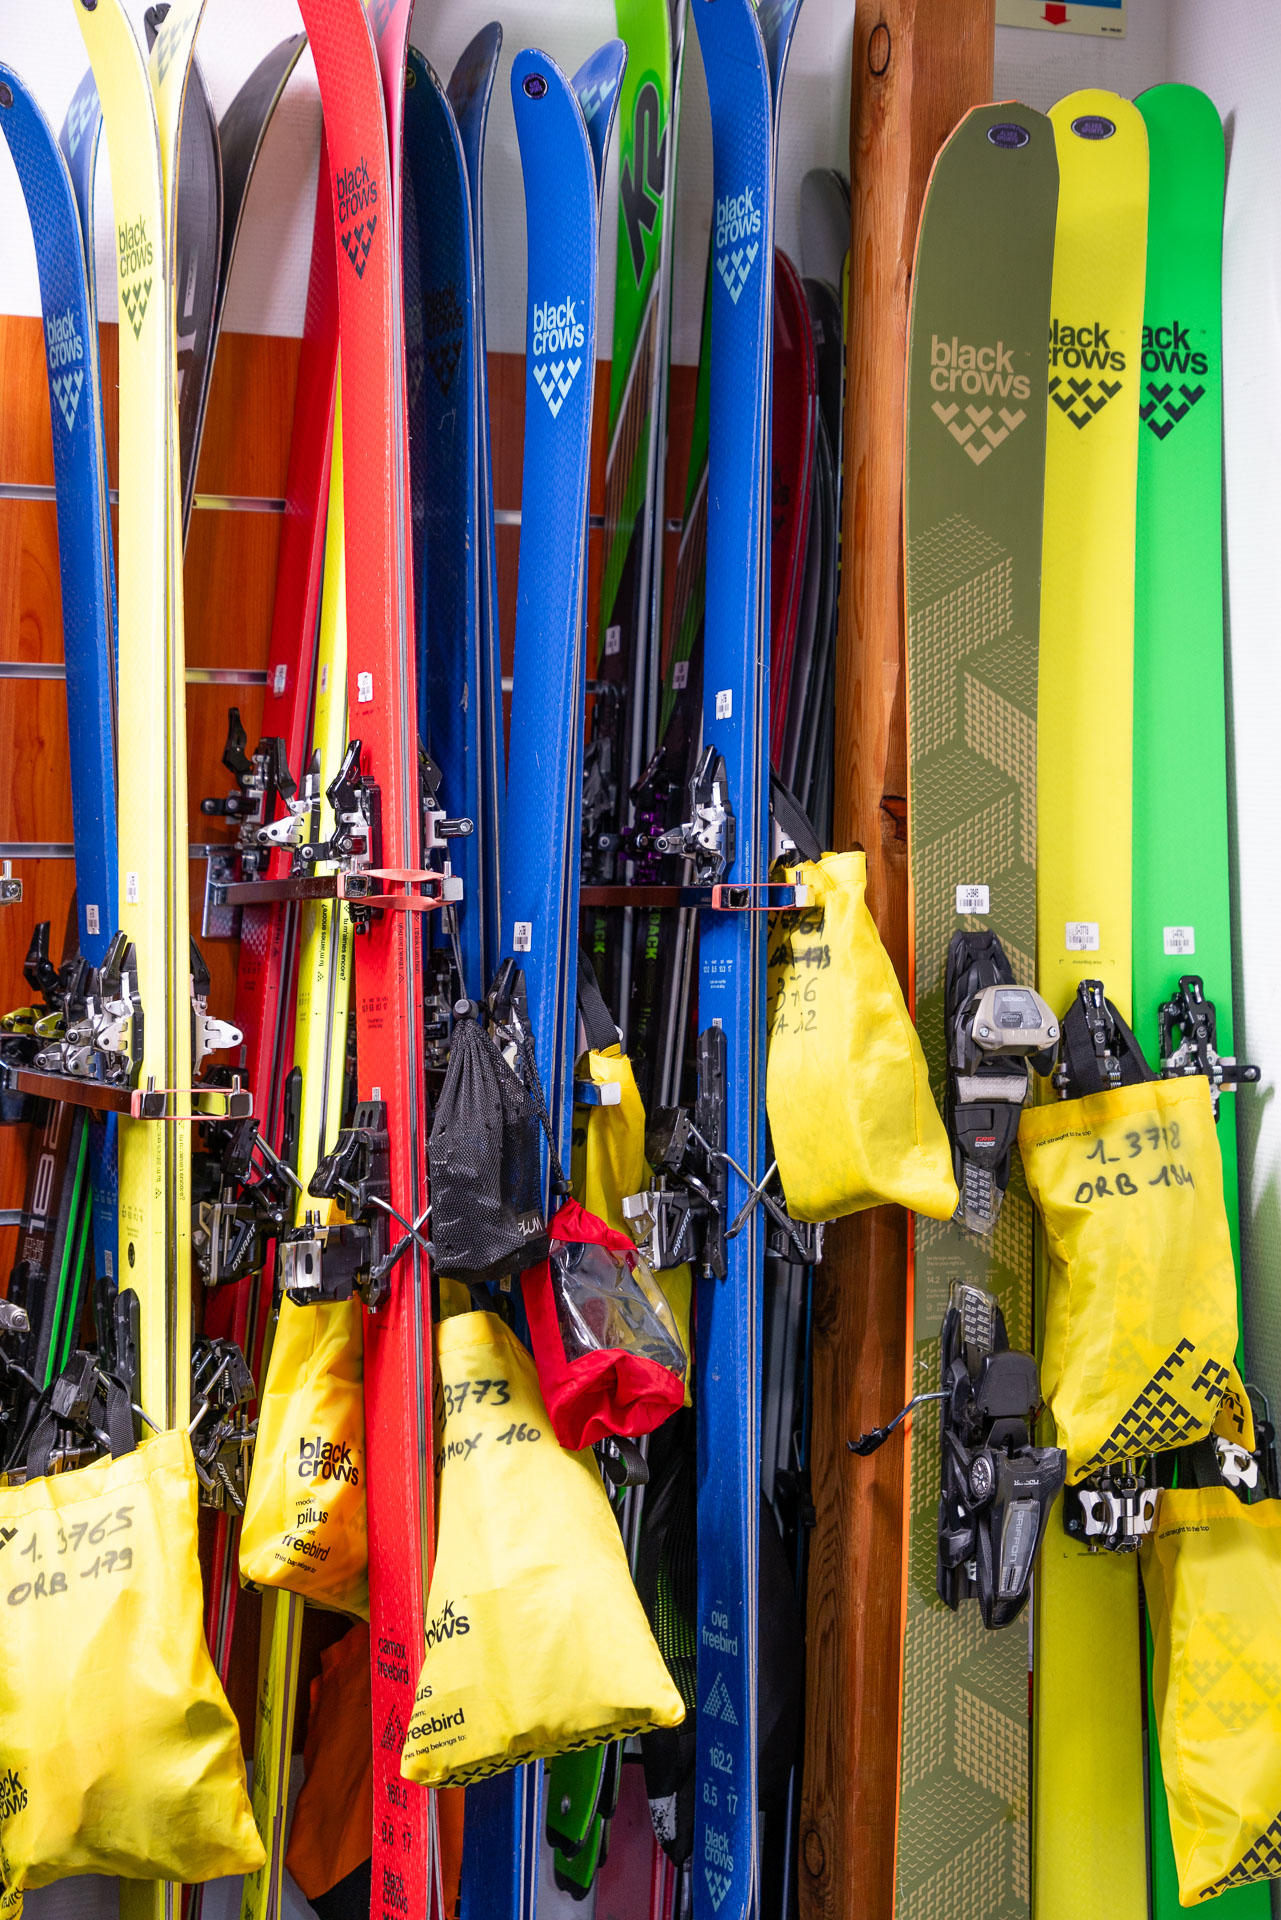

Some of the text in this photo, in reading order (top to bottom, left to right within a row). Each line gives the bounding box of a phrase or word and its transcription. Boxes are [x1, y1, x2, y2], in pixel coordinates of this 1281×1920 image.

[336, 156, 370, 200] black
[338, 181, 378, 224] crows
[716, 186, 754, 225] black
[118, 213, 147, 254] black
[716, 209, 761, 249] crows
[120, 241, 153, 279] crows
[46, 307, 76, 346] black
[533, 296, 576, 332] black
[533, 323, 585, 356] crows
[1048, 319, 1110, 349] lack
[1142, 321, 1190, 350] ack
[49, 333, 84, 369] crows
[930, 334, 1015, 373] black
[1048, 346, 1126, 371] rows
[1142, 350, 1209, 375] ows
[930, 366, 1031, 400] crows
[1036, 1139, 1047, 1148] not
[1047, 1133, 1069, 1145] straight
[1081, 1130, 1092, 1138] top
[1074, 1172, 1139, 1204] ORB
[231, 1223, 256, 1272] DYNAFIT
[673, 1208, 691, 1257] DYNAFIT
[984, 1275, 993, 1283] 21
[444, 1379, 511, 1417] 3773
[496, 1422, 541, 1446] 160
[299, 1436, 352, 1465] black
[216, 1462, 244, 1507] DYNAFIT
[298, 1460, 359, 1486] crows
[57, 1505, 135, 1555] 3765
[296, 1507, 329, 1528] pilus
[1166, 1527, 1186, 1538] straight
[281, 1534, 331, 1562] freebird
[1010, 1510, 1025, 1563] GRIFFON
[7, 1546, 133, 1606] ORB 179
[711, 1610, 728, 1630] ova
[378, 1637, 406, 1660] camox
[702, 1625, 738, 1656] freebird
[377, 1655, 409, 1685] freebird
[406, 1707, 465, 1744] reebird
[415, 1745, 430, 1756] bag
[430, 1737, 457, 1751] belongs
[457, 1734, 467, 1743] to:
[709, 1746, 733, 1775] 162.2
[387, 1782, 408, 1810] 160.2
[703, 1782, 738, 1815] 8.5 17
[381, 1821, 412, 1854] 9.6 17
[705, 1822, 729, 1853] black
[705, 1844, 734, 1873] crows
[384, 1864, 404, 1893] black
[383, 1887, 408, 1914] crows
